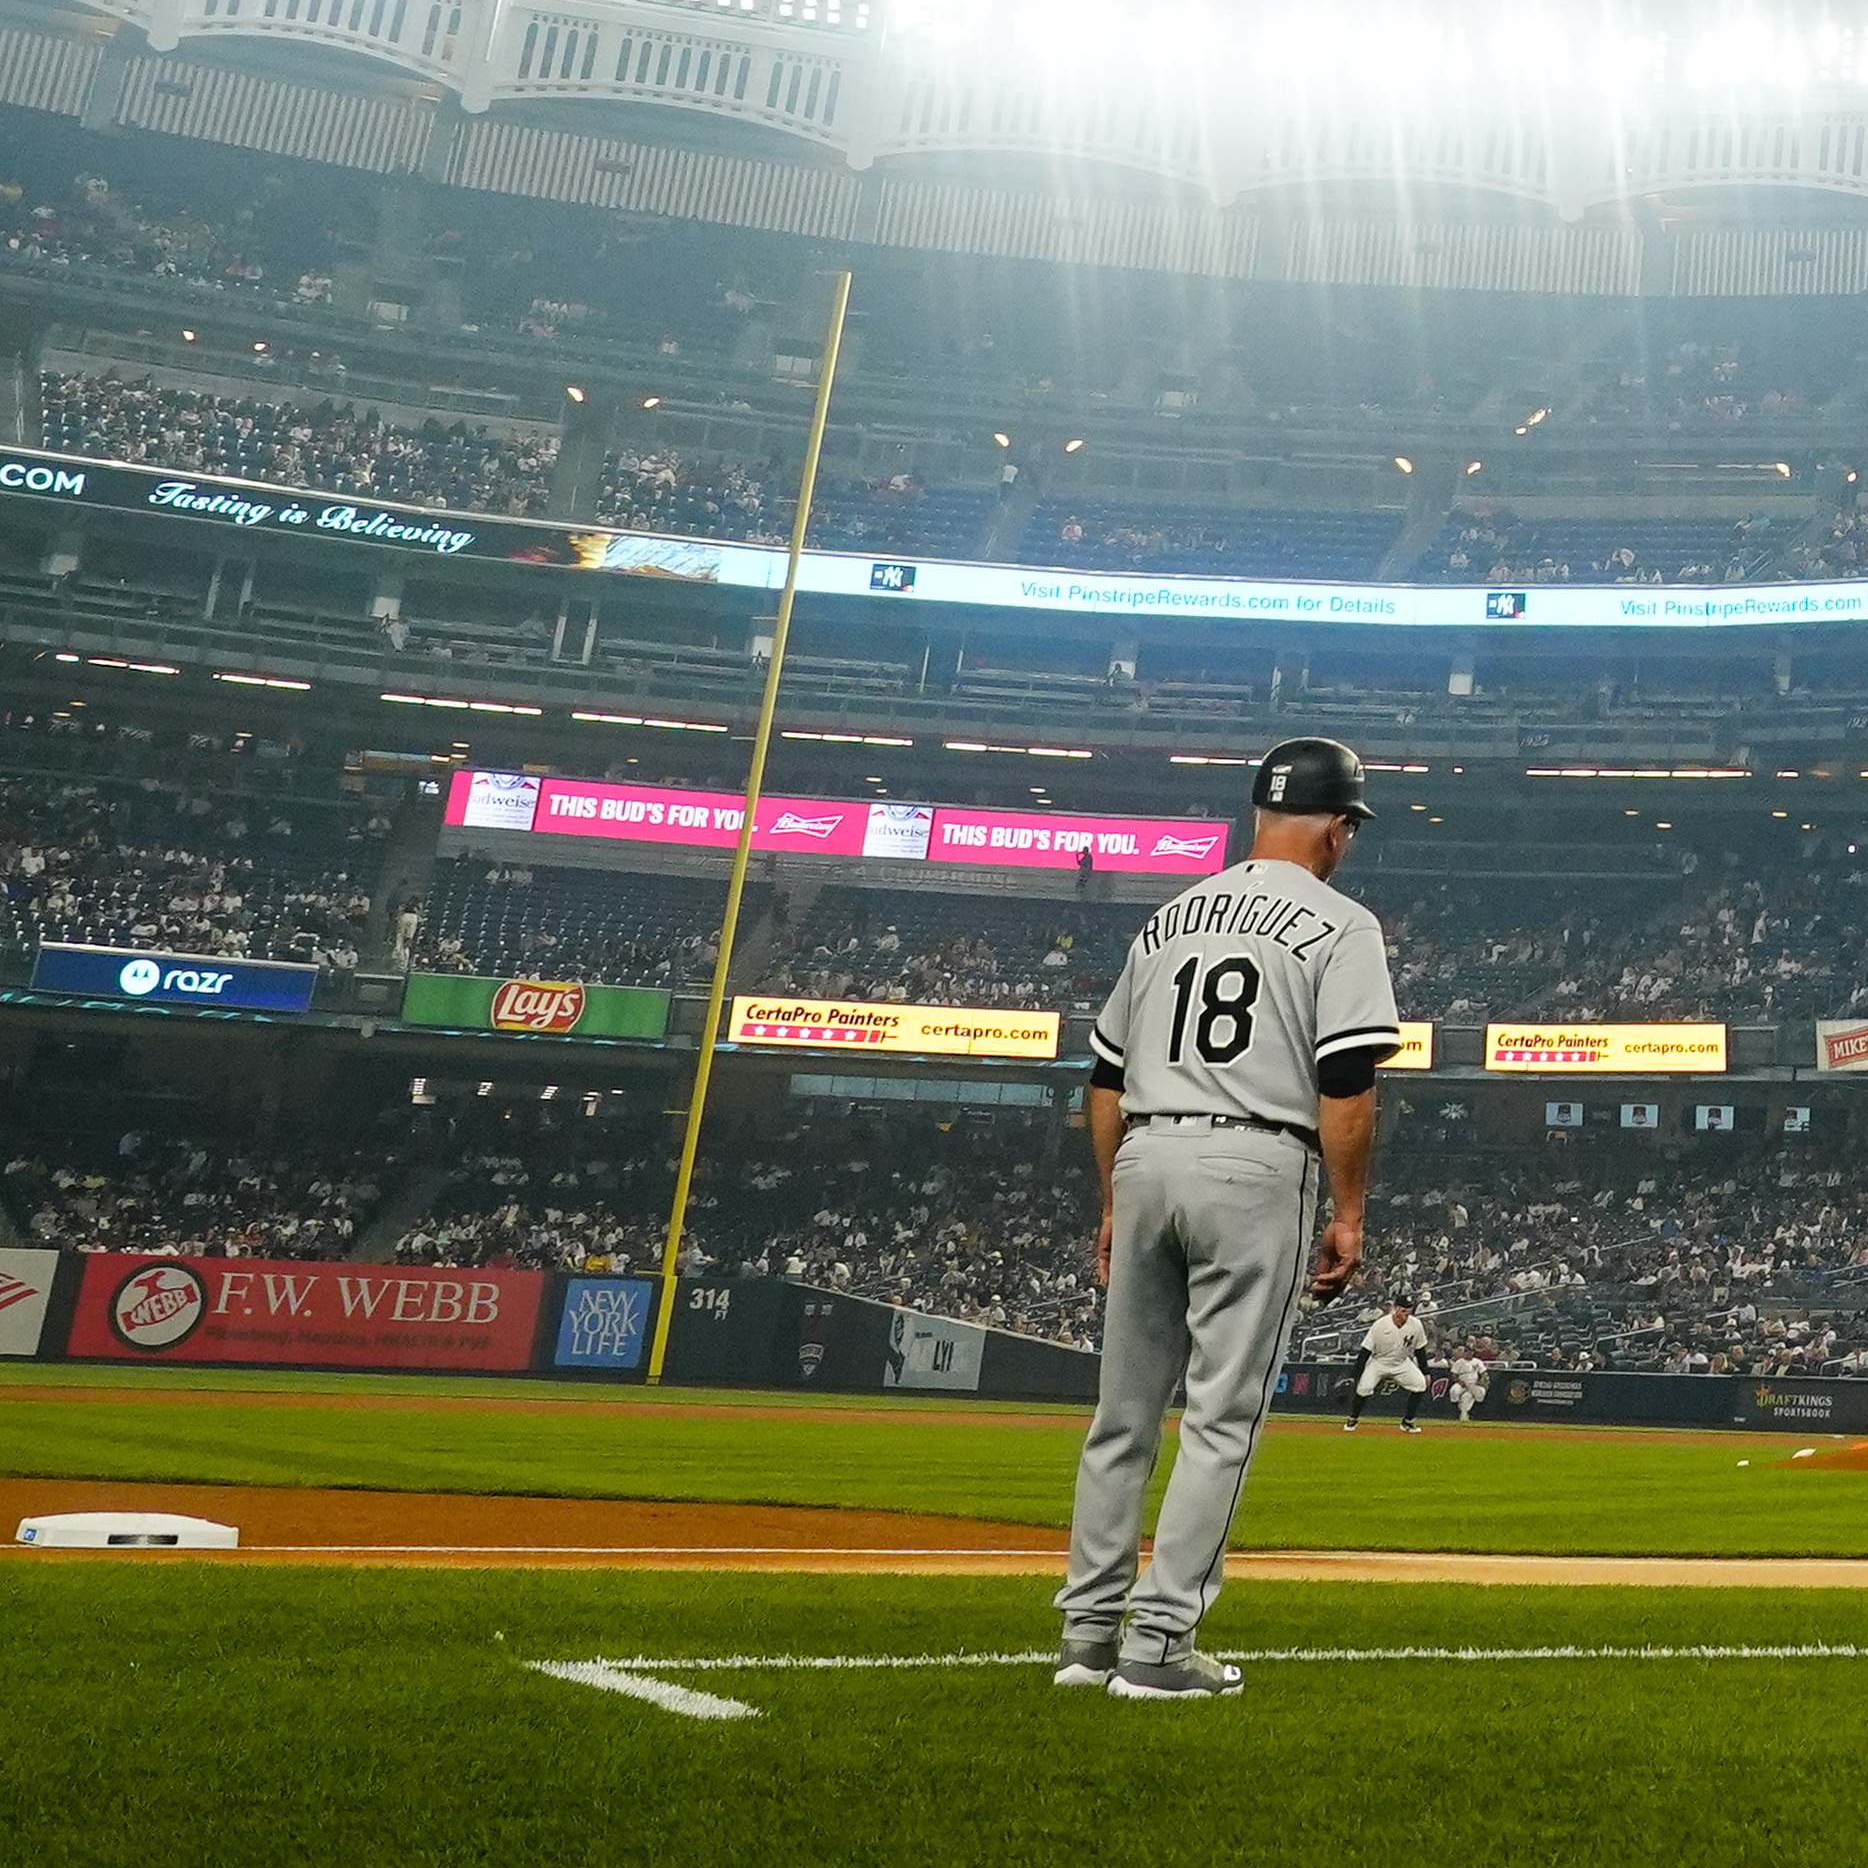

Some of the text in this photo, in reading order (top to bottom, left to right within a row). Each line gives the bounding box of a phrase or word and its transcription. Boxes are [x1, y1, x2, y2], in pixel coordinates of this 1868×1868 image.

[0, 463, 85, 495] COM
[148, 481, 476, 554] Tasting is Believing
[1020, 581, 1396, 615] Visit PinstripeRewards.com for Details
[1620, 599, 1658, 617] Visit
[1664, 594, 1862, 618] PinstripeRewards.com
[1269, 775, 1287, 792] 18
[550, 794, 598, 818] THIS
[600, 798, 664, 824] BUD'S
[667, 805, 709, 829] FOR
[942, 823, 986, 845] THIS
[989, 828, 1050, 850] BUD'S
[1053, 832, 1093, 852] FOR
[1098, 835, 1140, 855] YOU.
[163, 968, 233, 996] razr
[746, 1003, 899, 1028] CertaPro Painters
[1167, 952, 1264, 1070] 18
[921, 1022, 1049, 1042] certapro.com
[1497, 1033, 1609, 1050] CertaPro Painters
[1624, 1040, 1719, 1056] certapro.com
[132, 1288, 189, 1326] WEBB
[212, 1271, 501, 1325] F.W. WEBB
[579, 1289, 637, 1314] NEW
[690, 1288, 730, 1310] 314
[570, 1311, 638, 1336] YORK
[714, 1310, 728, 1321] FT
[571, 1333, 628, 1357] LIFE
[1756, 1392, 1833, 1408] DRAFTKINGS
[1774, 1408, 1832, 1419] SPORTSBOOK
